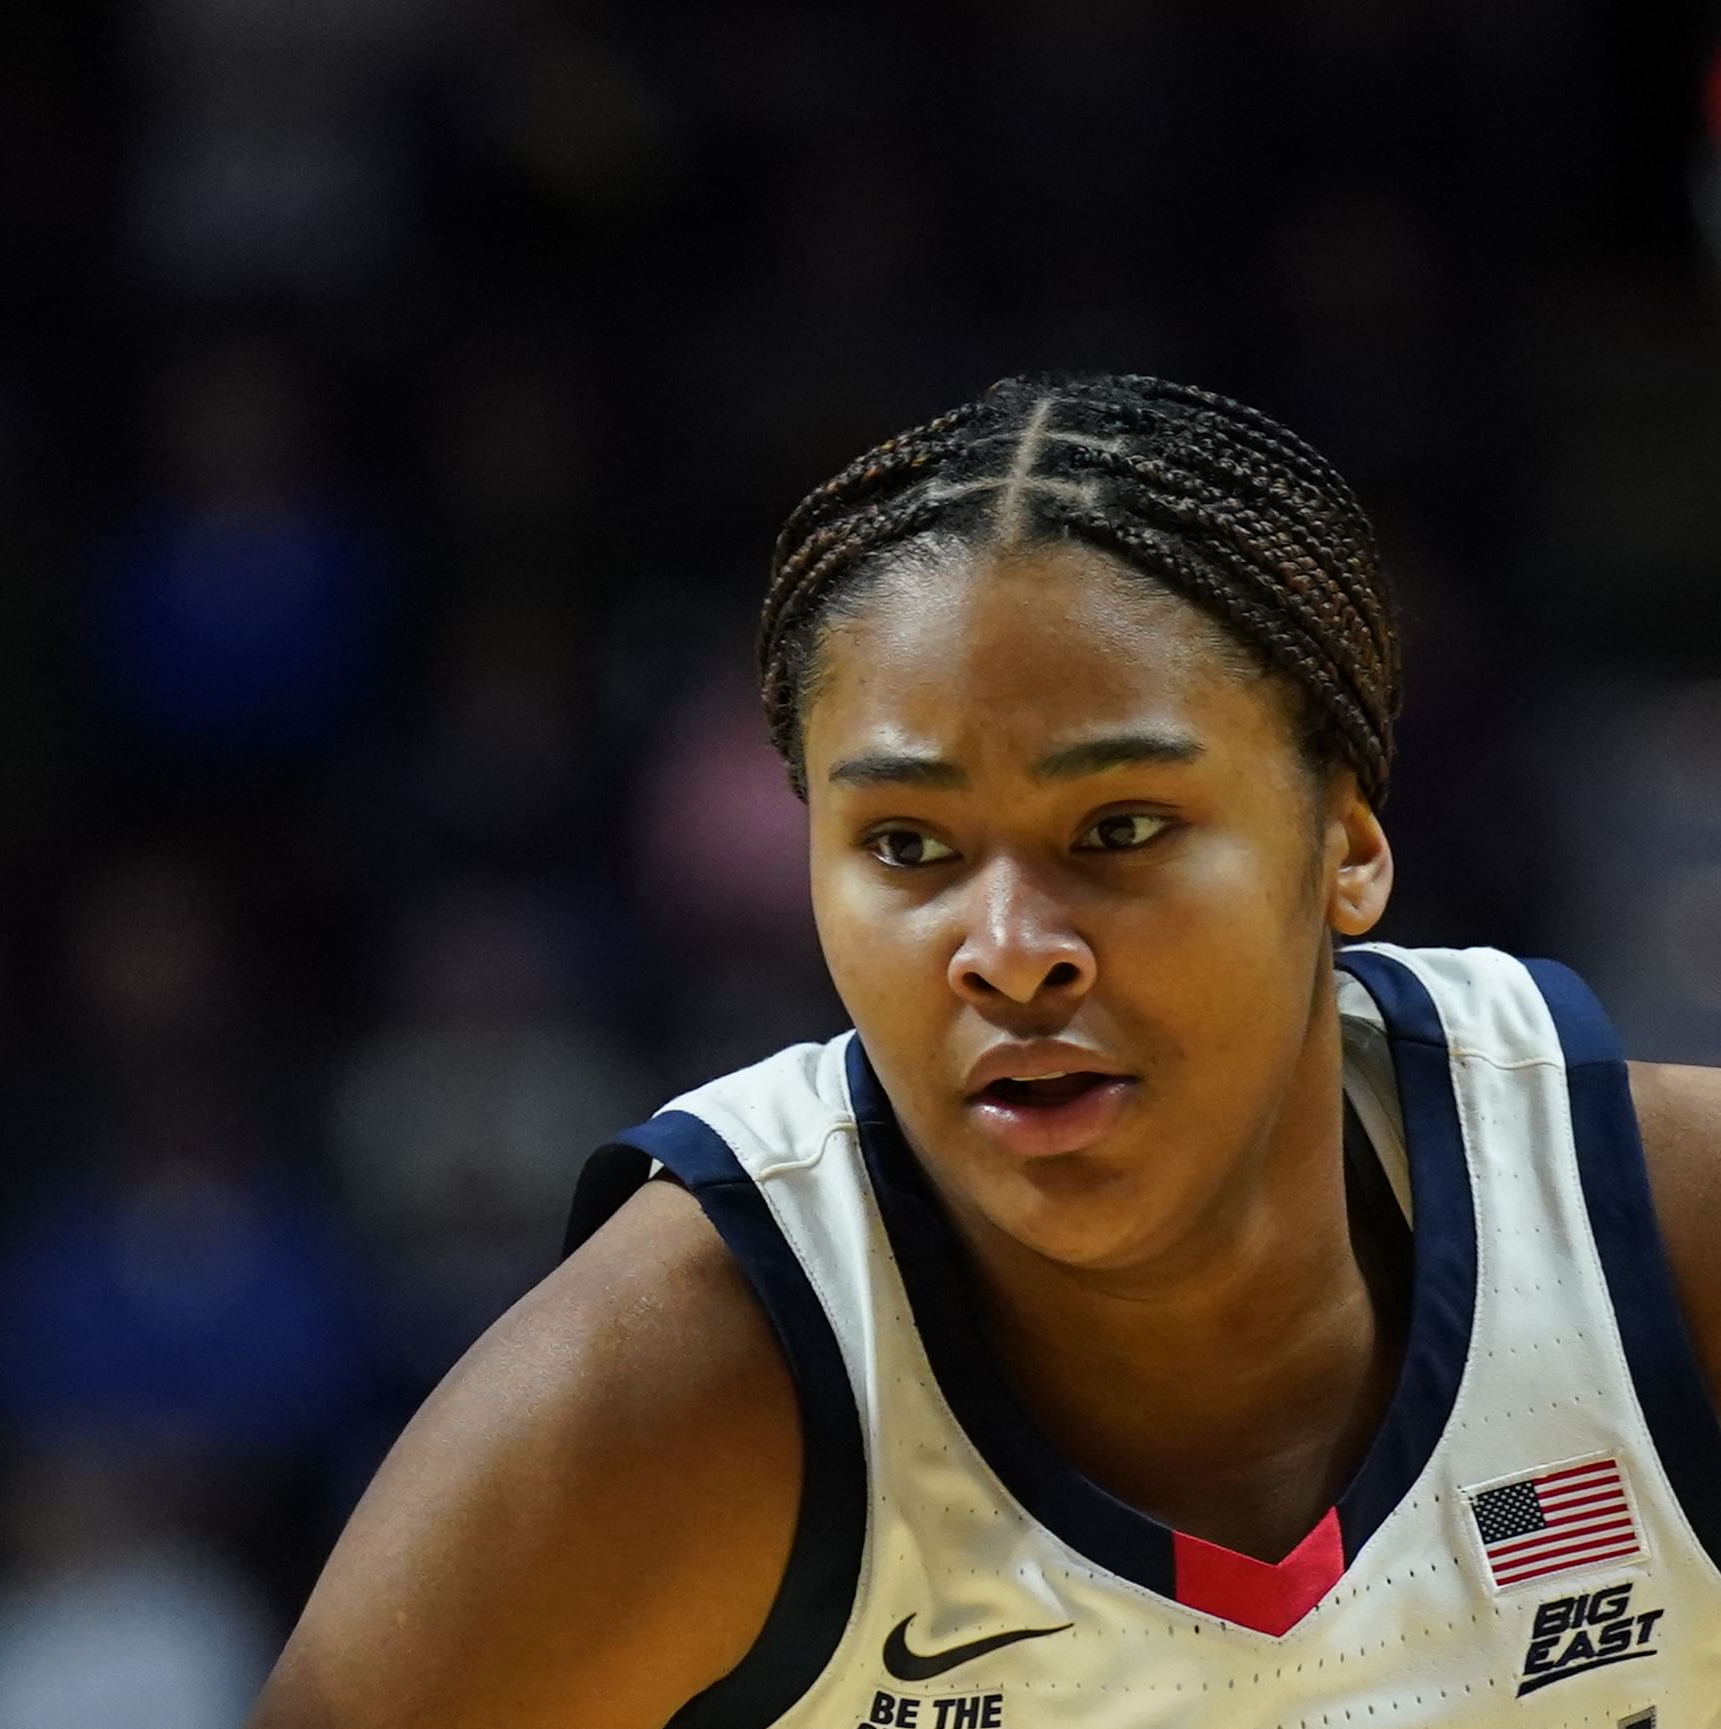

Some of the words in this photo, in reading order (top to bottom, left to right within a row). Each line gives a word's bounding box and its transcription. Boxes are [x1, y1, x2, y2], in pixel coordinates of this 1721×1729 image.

[1532, 1582, 1633, 1639] BIG
[1523, 1609, 1665, 1676] EAST
[870, 1690, 921, 1729] BE
